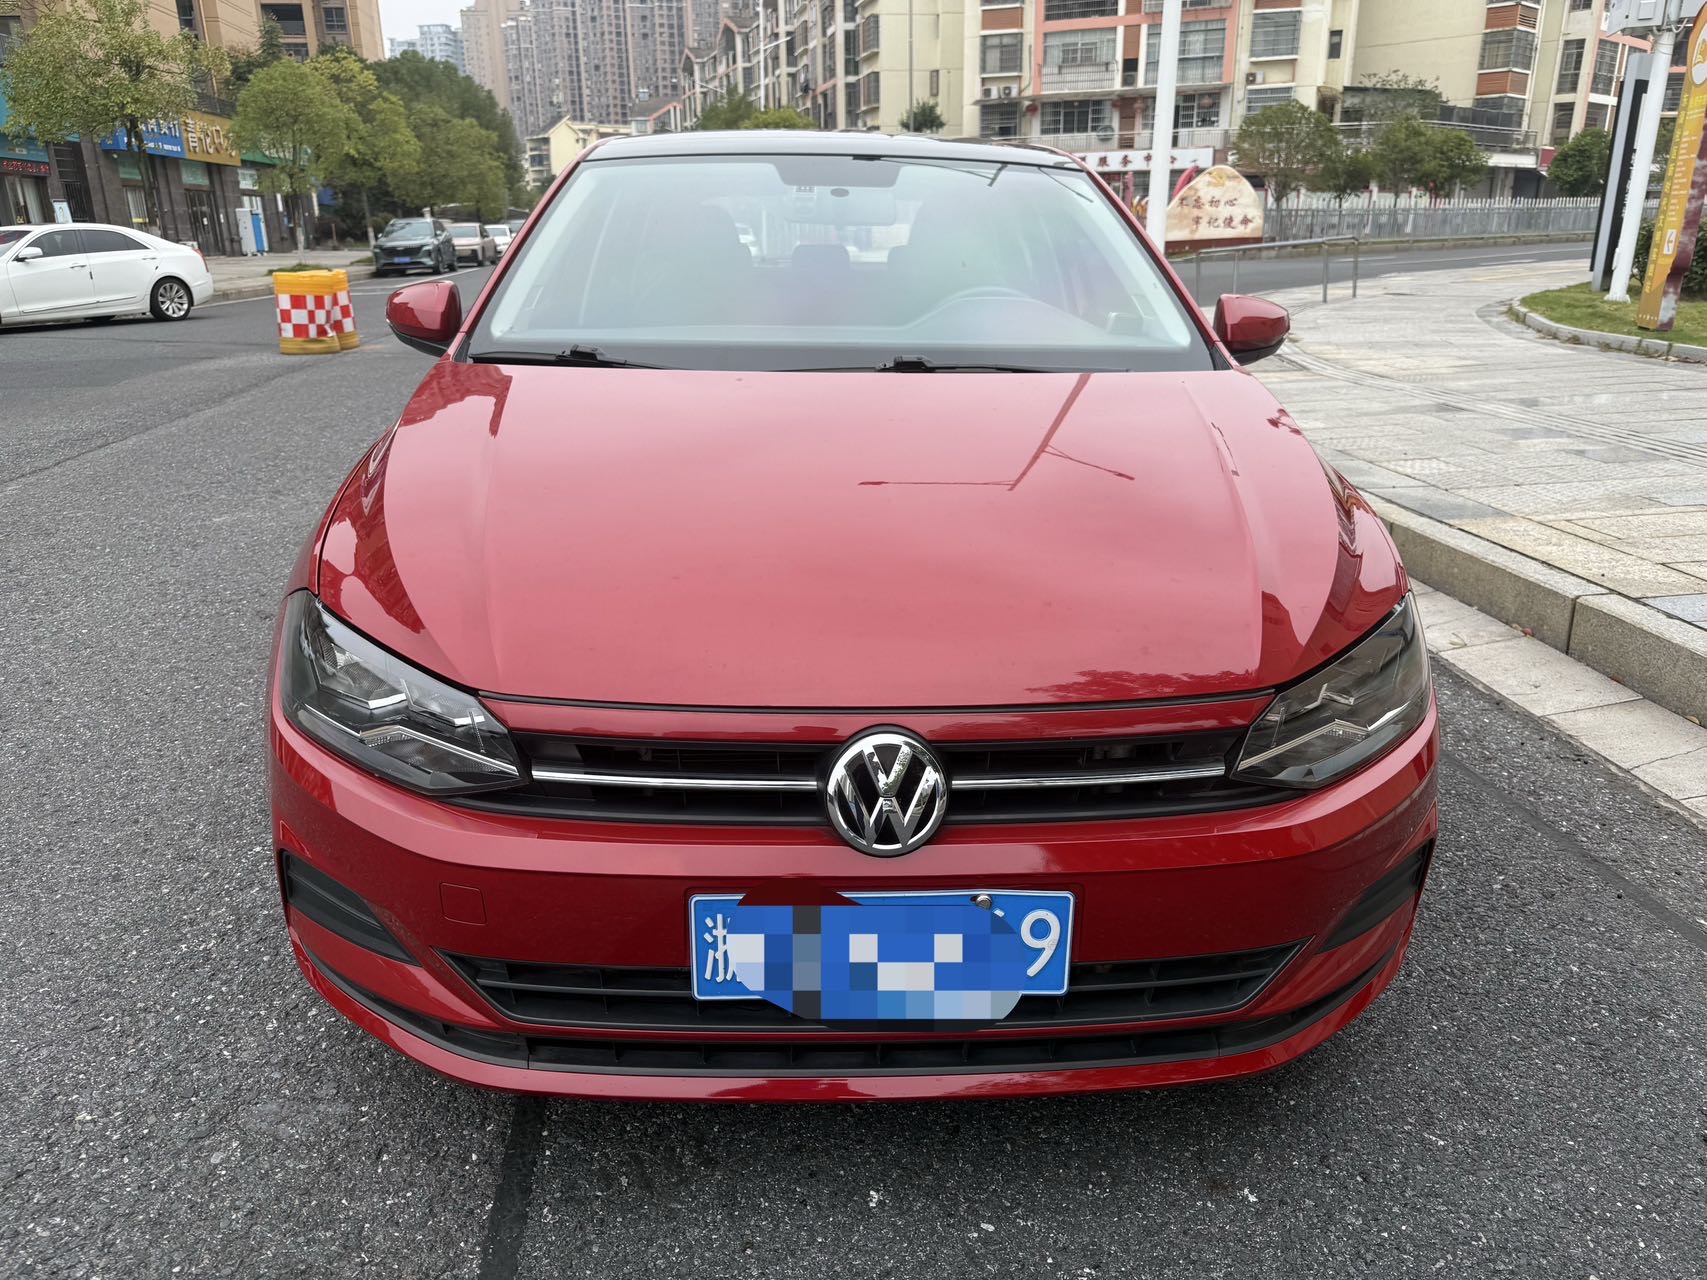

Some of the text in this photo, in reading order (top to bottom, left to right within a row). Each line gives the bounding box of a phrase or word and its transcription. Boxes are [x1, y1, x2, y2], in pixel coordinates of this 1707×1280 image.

[1177, 195, 1238, 209] 不忘初心
[1191, 214, 1254, 231] 牢记使命
